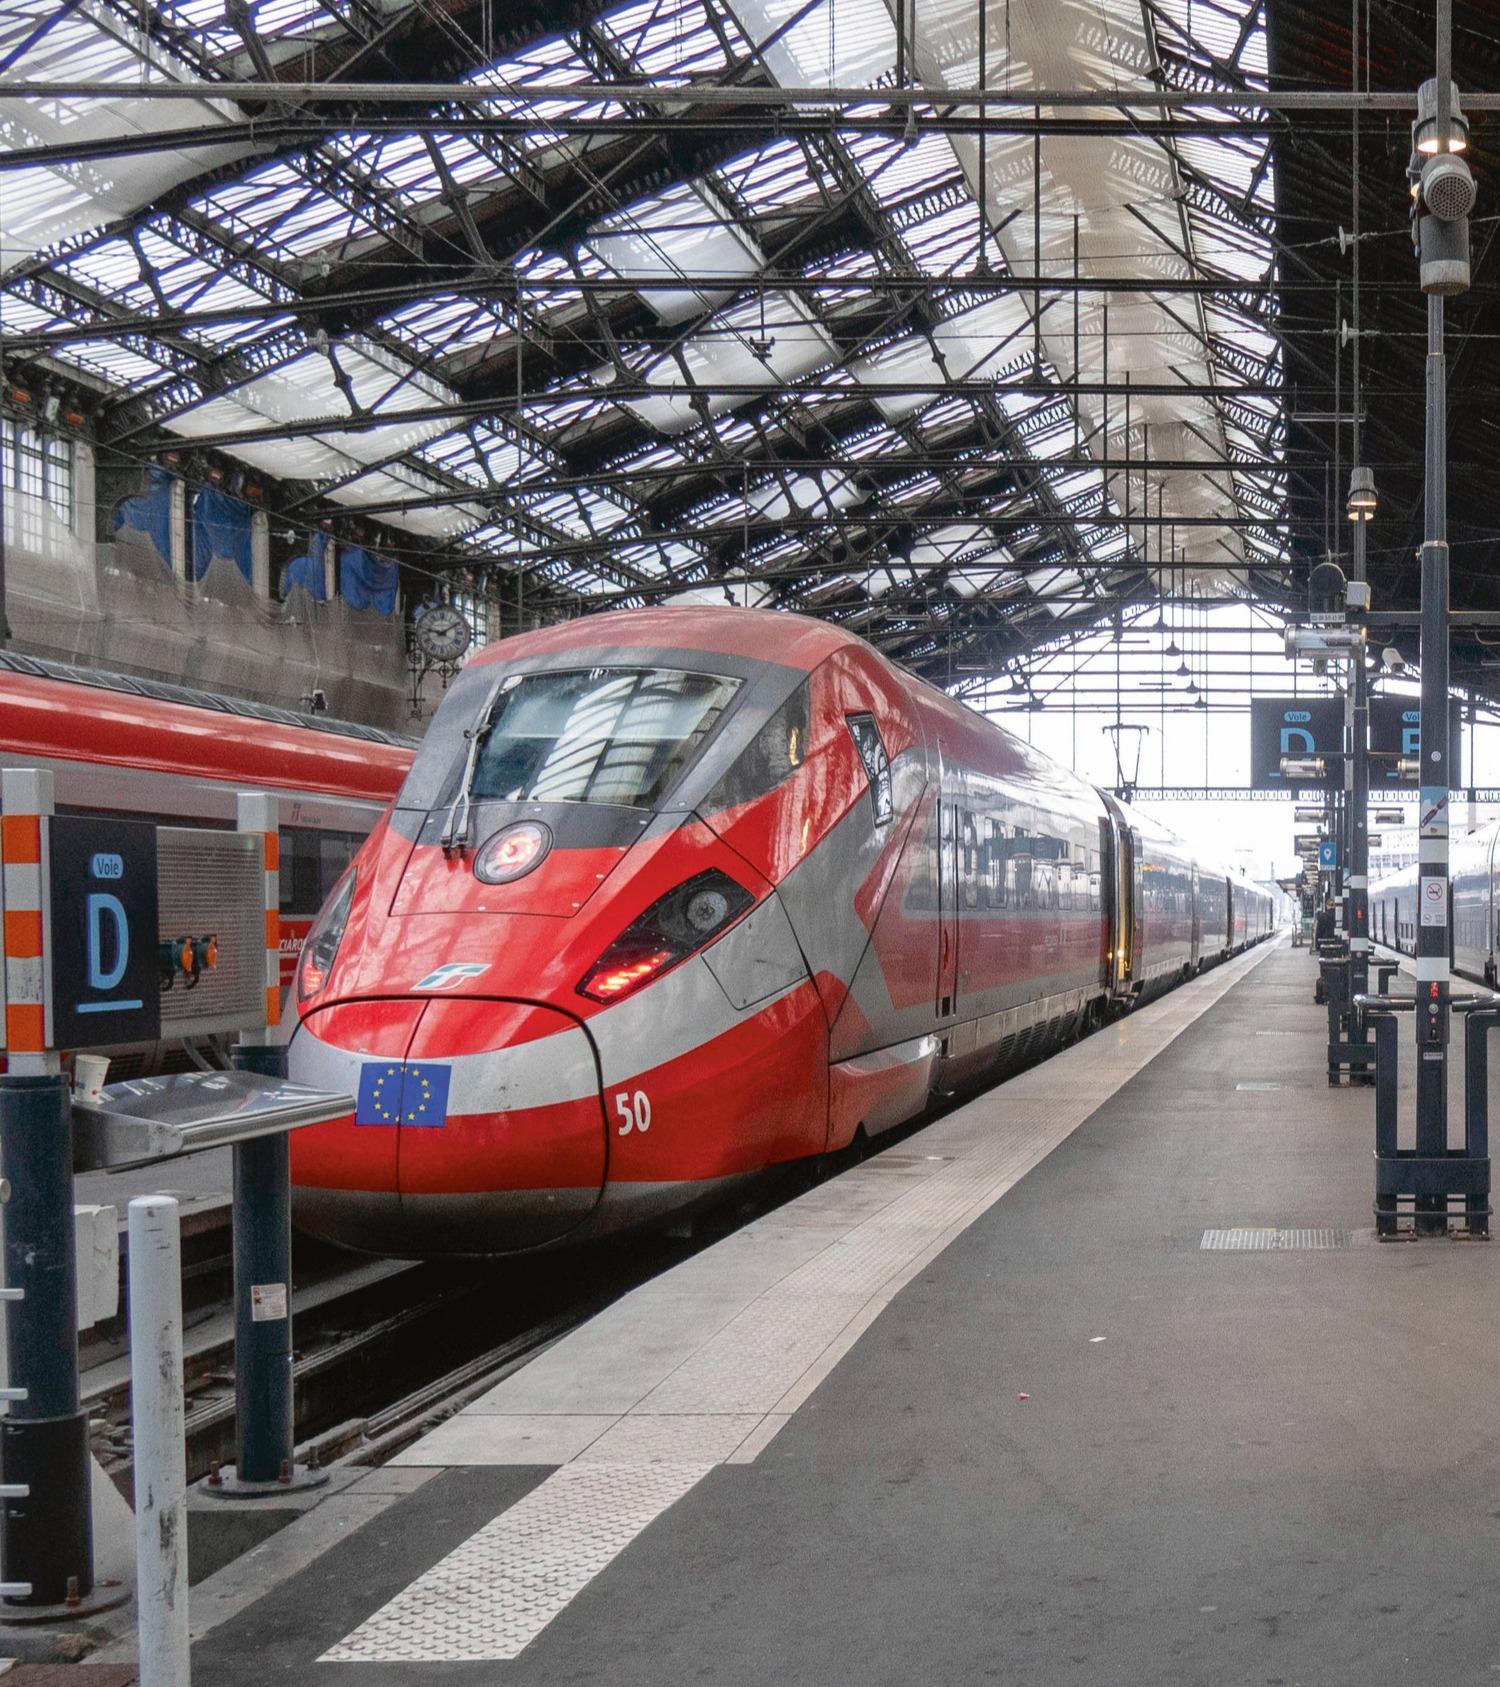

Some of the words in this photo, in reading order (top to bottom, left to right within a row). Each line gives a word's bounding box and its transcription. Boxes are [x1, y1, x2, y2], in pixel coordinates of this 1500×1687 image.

[1281, 728, 1315, 761] D
[95, 857, 119, 875] Voie
[88, 893, 129, 990] D
[615, 1090, 652, 1136] 50
